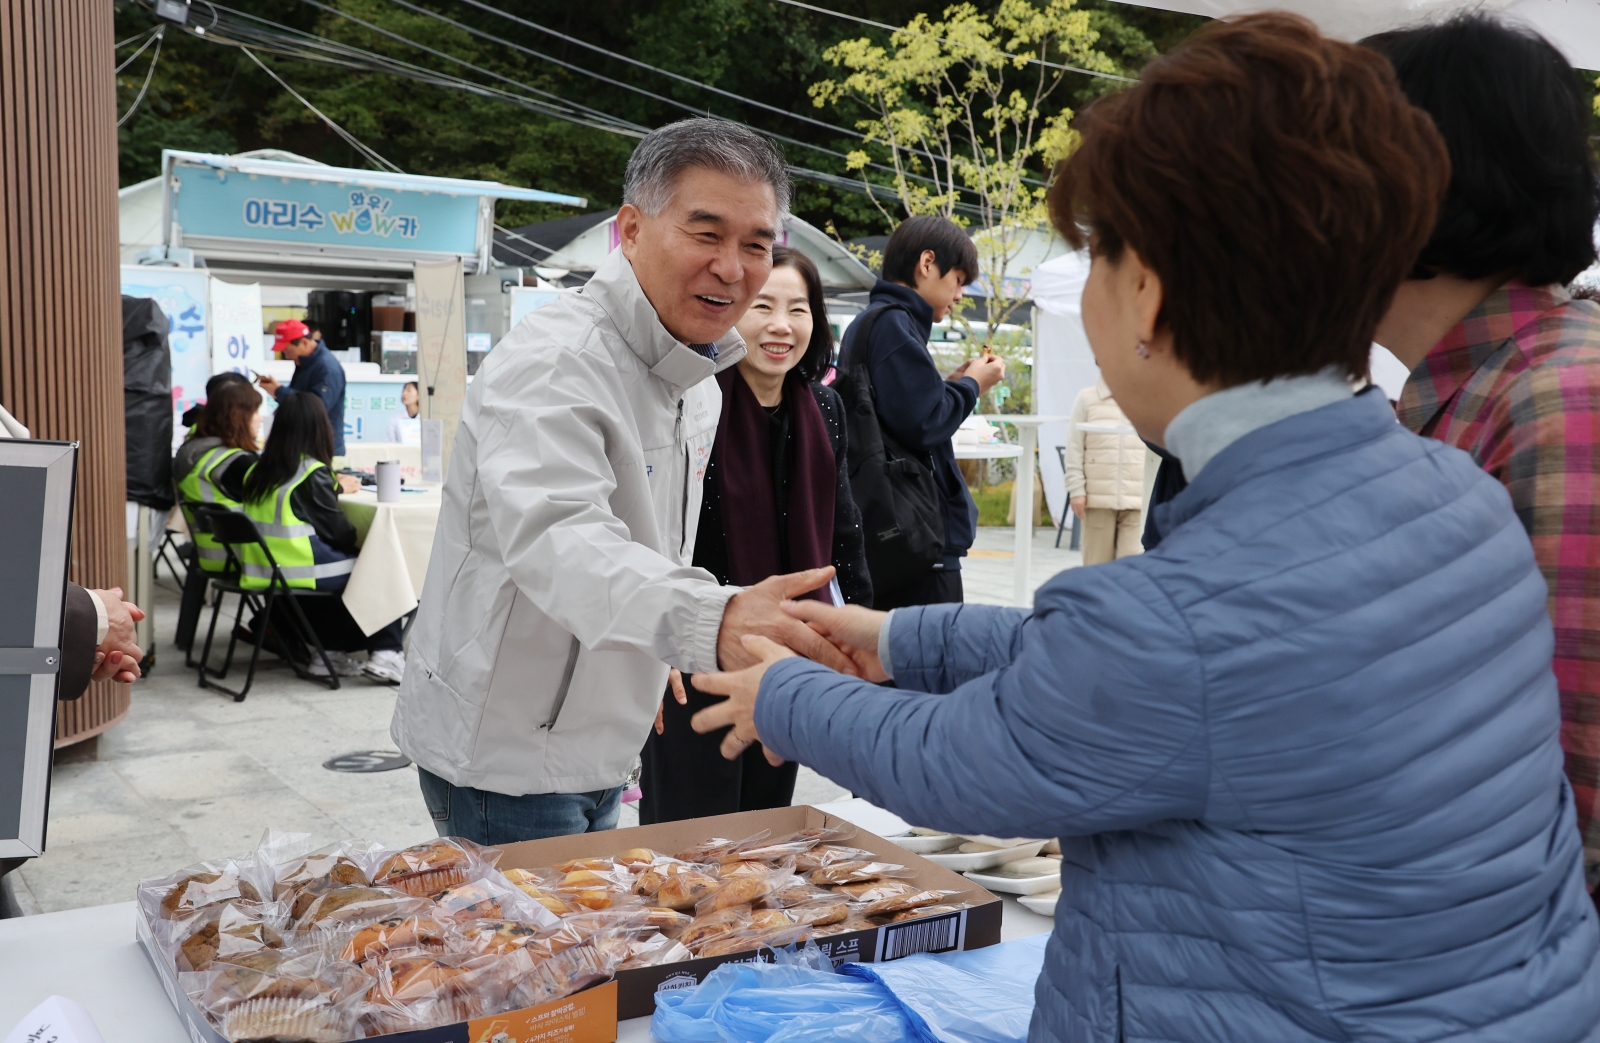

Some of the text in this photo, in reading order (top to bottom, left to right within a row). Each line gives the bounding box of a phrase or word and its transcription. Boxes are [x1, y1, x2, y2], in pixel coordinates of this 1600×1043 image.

[351, 192, 390, 213] 와우!
[245, 200, 324, 230] 아리수
[343, 396, 397, 410] 는 물은
[836, 938, 860, 955] 스프
[531, 1012, 550, 1023] 스프와
